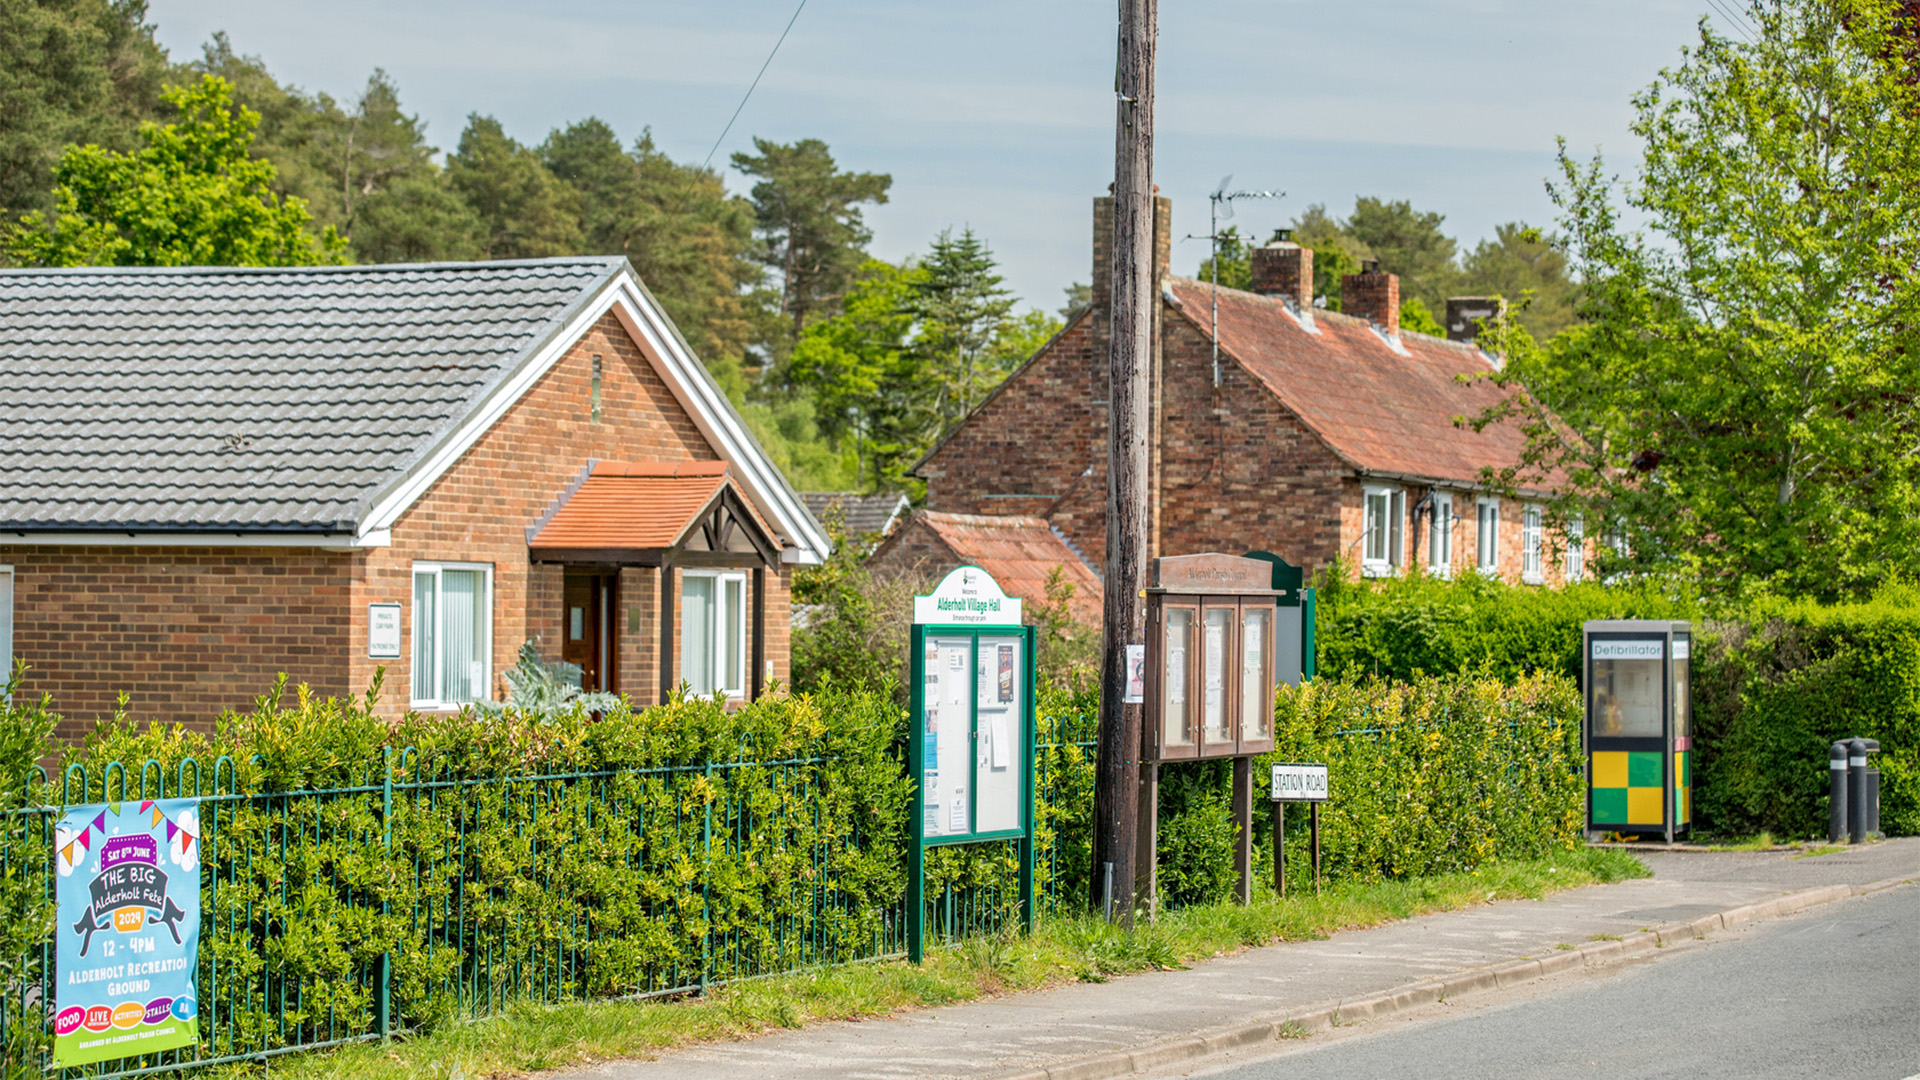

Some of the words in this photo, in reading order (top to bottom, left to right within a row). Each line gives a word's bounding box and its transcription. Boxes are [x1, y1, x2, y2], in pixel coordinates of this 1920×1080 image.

[937, 597, 966, 611] Alderholt
[966, 597, 988, 615] Village
[988, 598, 1001, 612] Hall
[1594, 644, 1661, 655] Defibrillator
[1275, 773, 1304, 791] STATION
[1306, 774, 1326, 791] ROAD
[108, 849, 120, 861] SAT
[132, 846, 151, 858] JUNE
[101, 867, 126, 889] THE
[130, 867, 156, 884] BIG
[95, 887, 140, 912] Alderholt
[143, 888, 162, 905] Fete
[119, 912, 141, 925] 2024
[103, 940, 115, 957] 12
[129, 937, 155, 953] 4PM
[68, 965, 124, 985] ALDERHOLT
[107, 979, 150, 996] GROUND
[114, 1009, 143, 1021] ACTIVITIES
[146, 1003, 170, 1018] STALLS
[179, 1002, 189, 1013] BA
[58, 1011, 80, 1030] FOOD
[90, 1011, 108, 1022] LIVE
[112, 1033, 138, 1043] ALDERHOLT
[139, 1030, 155, 1039] PARISH
[156, 1027, 176, 1036] COUNCIL
